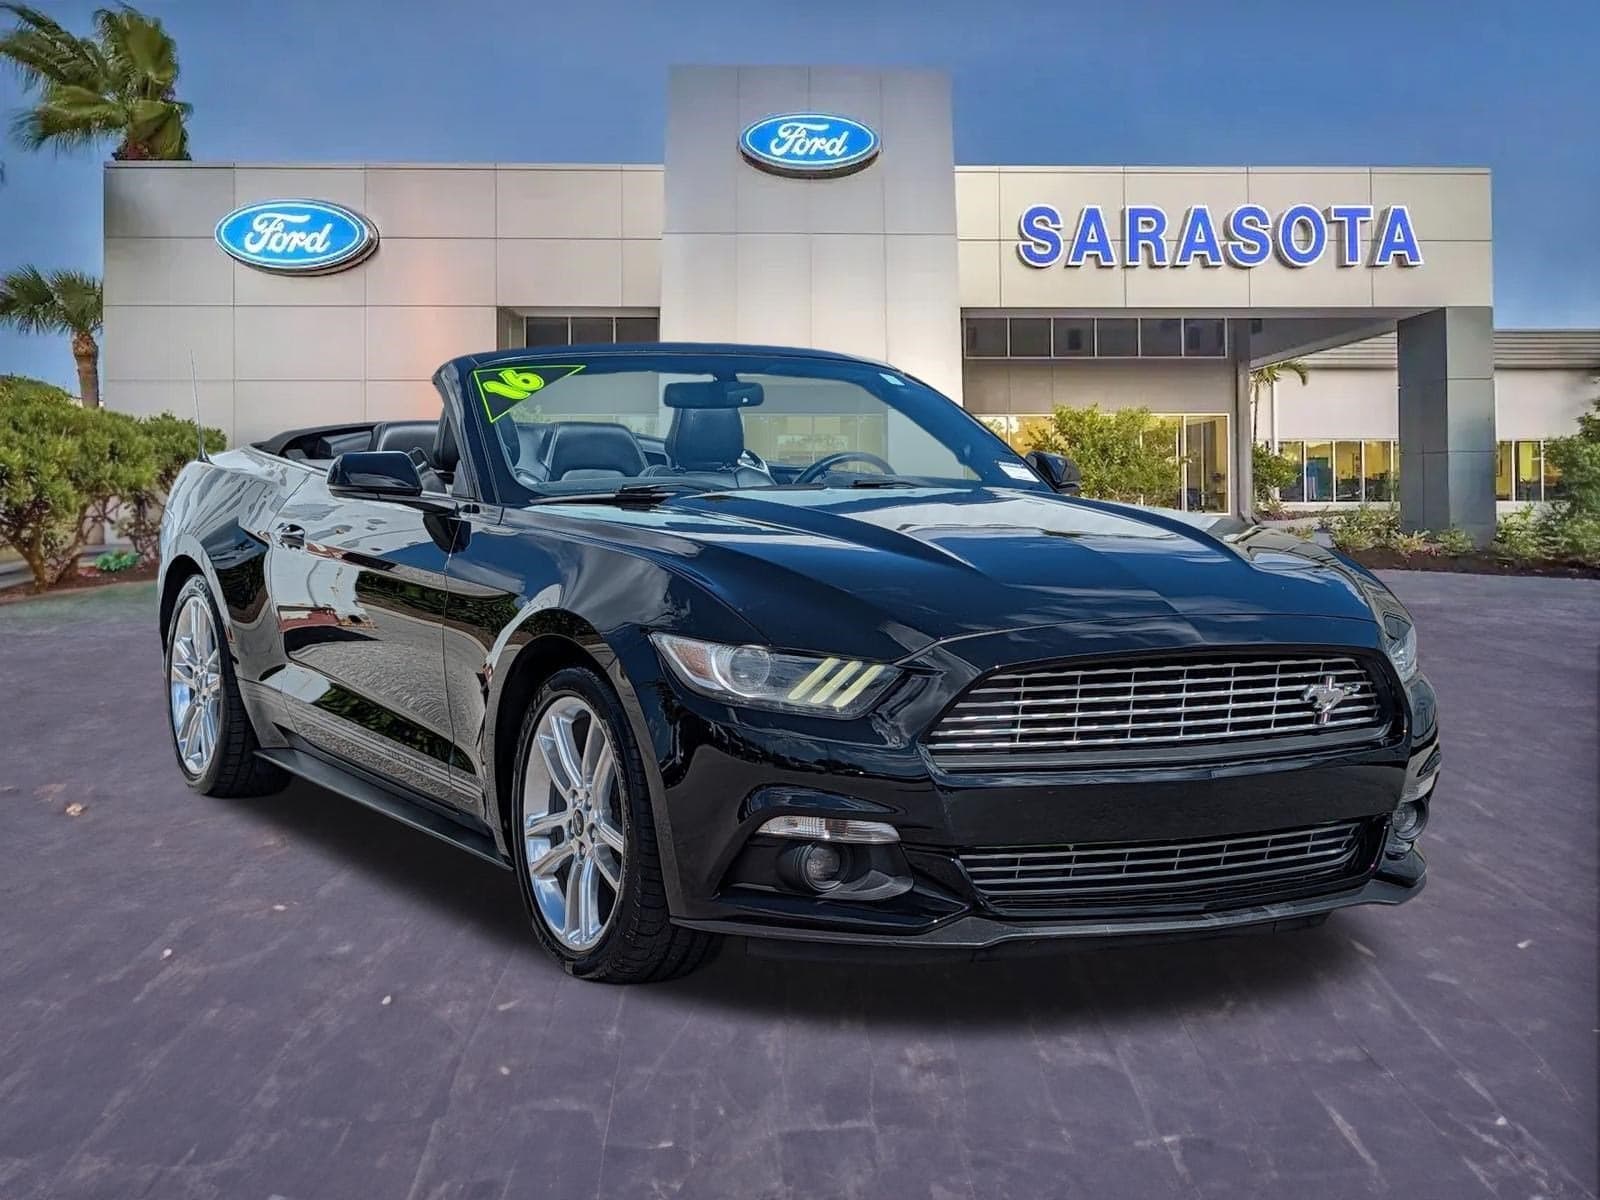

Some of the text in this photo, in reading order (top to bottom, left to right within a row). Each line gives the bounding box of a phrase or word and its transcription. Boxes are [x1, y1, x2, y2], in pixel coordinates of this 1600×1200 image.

[769, 122, 850, 157] Ford
[244, 212, 332, 253] Ford
[1018, 204, 1422, 267] SARASOTA
[482, 369, 545, 400] 16
